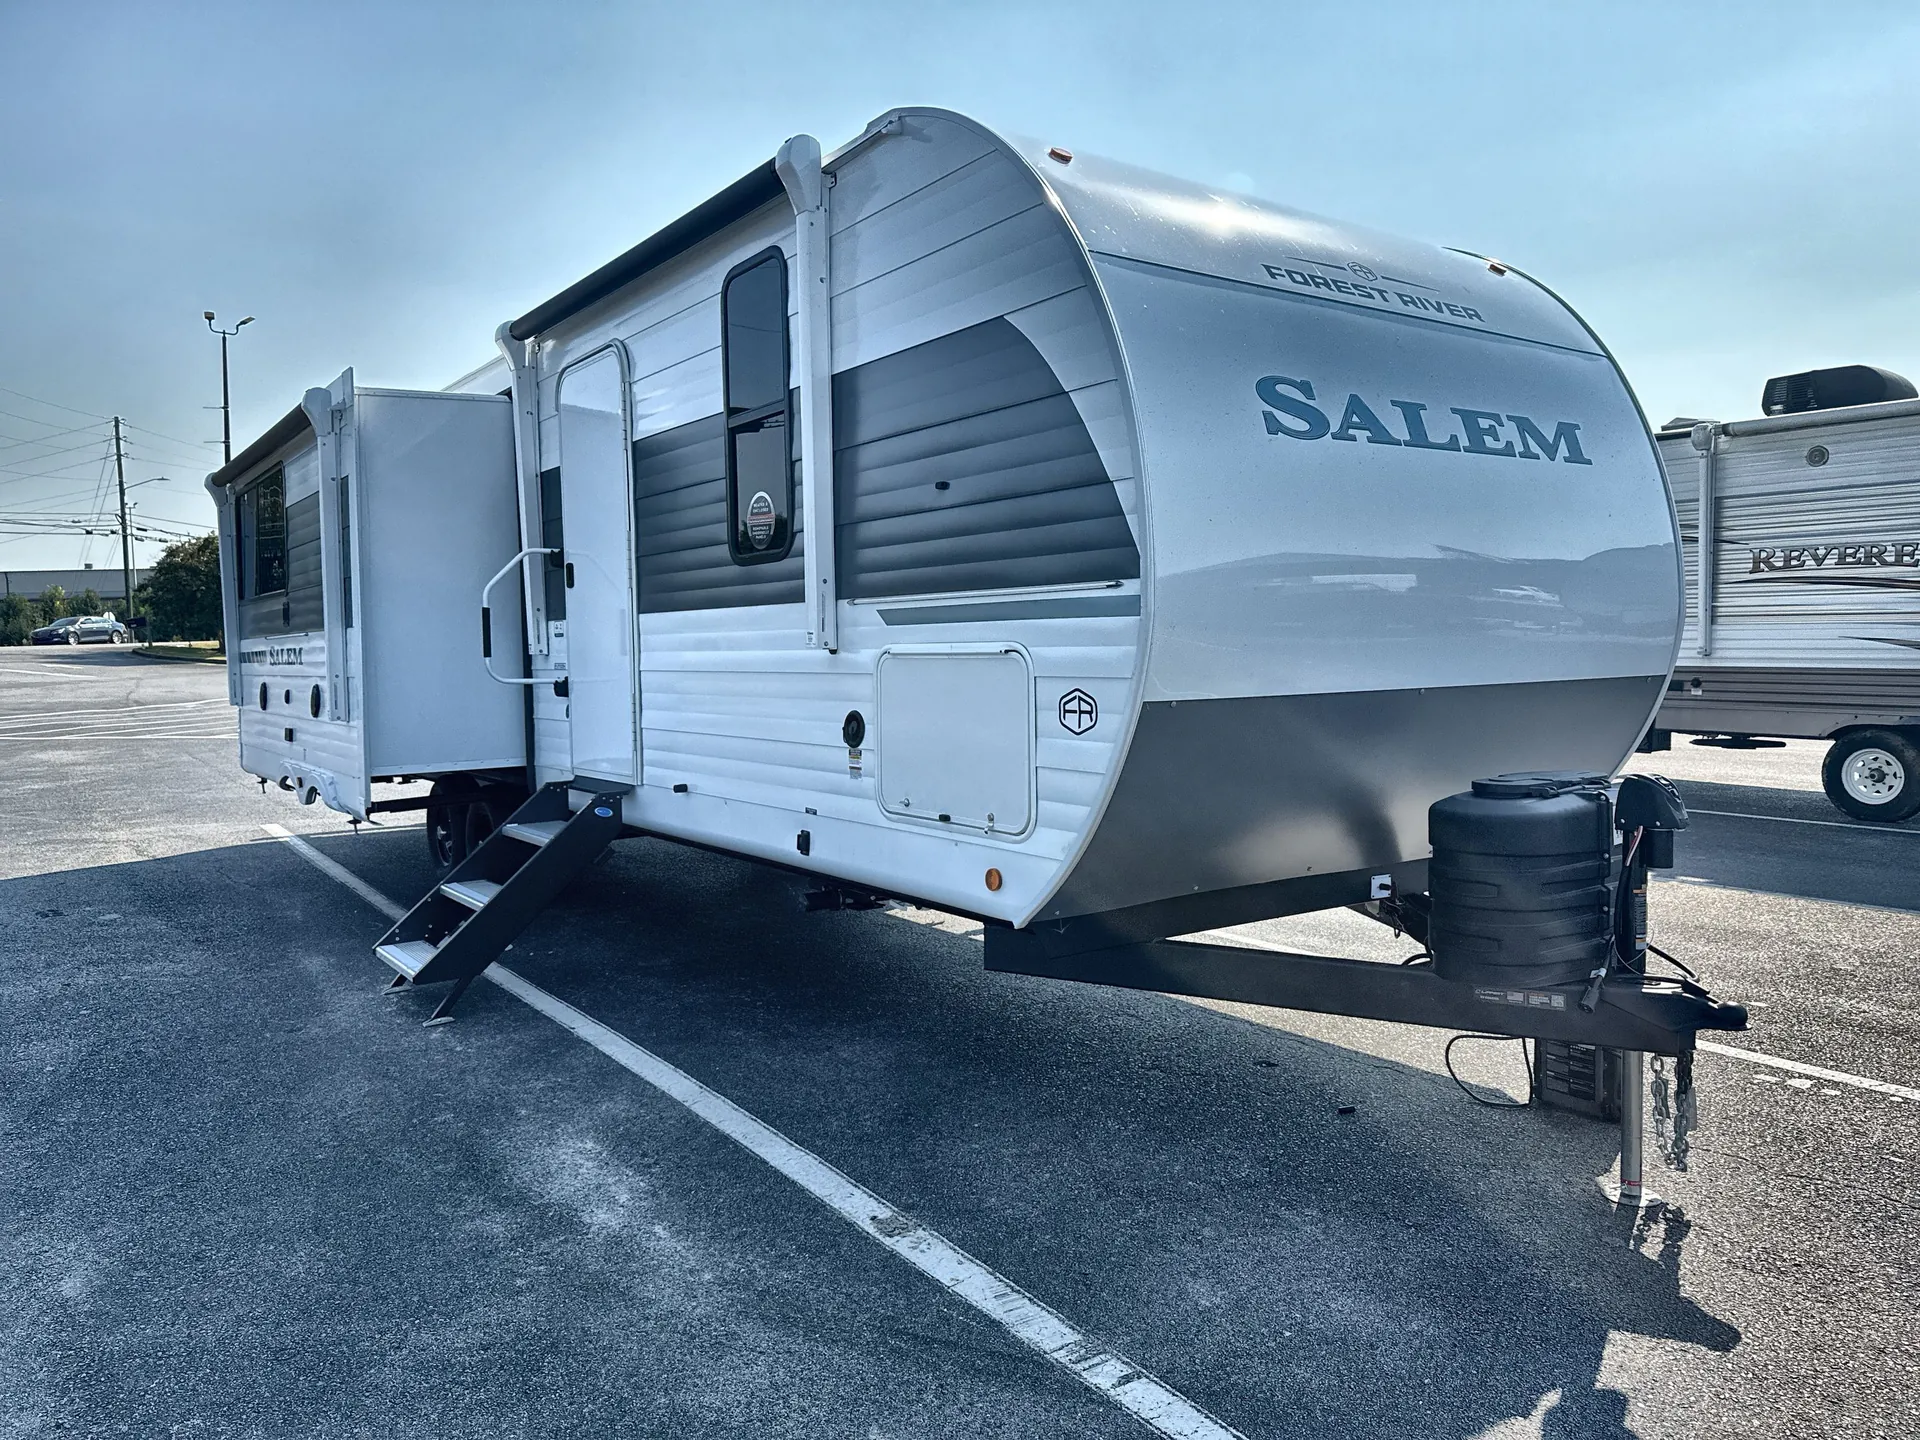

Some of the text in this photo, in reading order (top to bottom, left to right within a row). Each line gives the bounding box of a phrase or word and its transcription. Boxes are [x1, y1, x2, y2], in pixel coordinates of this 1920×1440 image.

[1260, 263, 1486, 323] FOREST RIVER
[1255, 375, 1593, 466] SALEM
[1749, 542, 1920, 574] REVERE
[269, 646, 303, 665] SALEM
